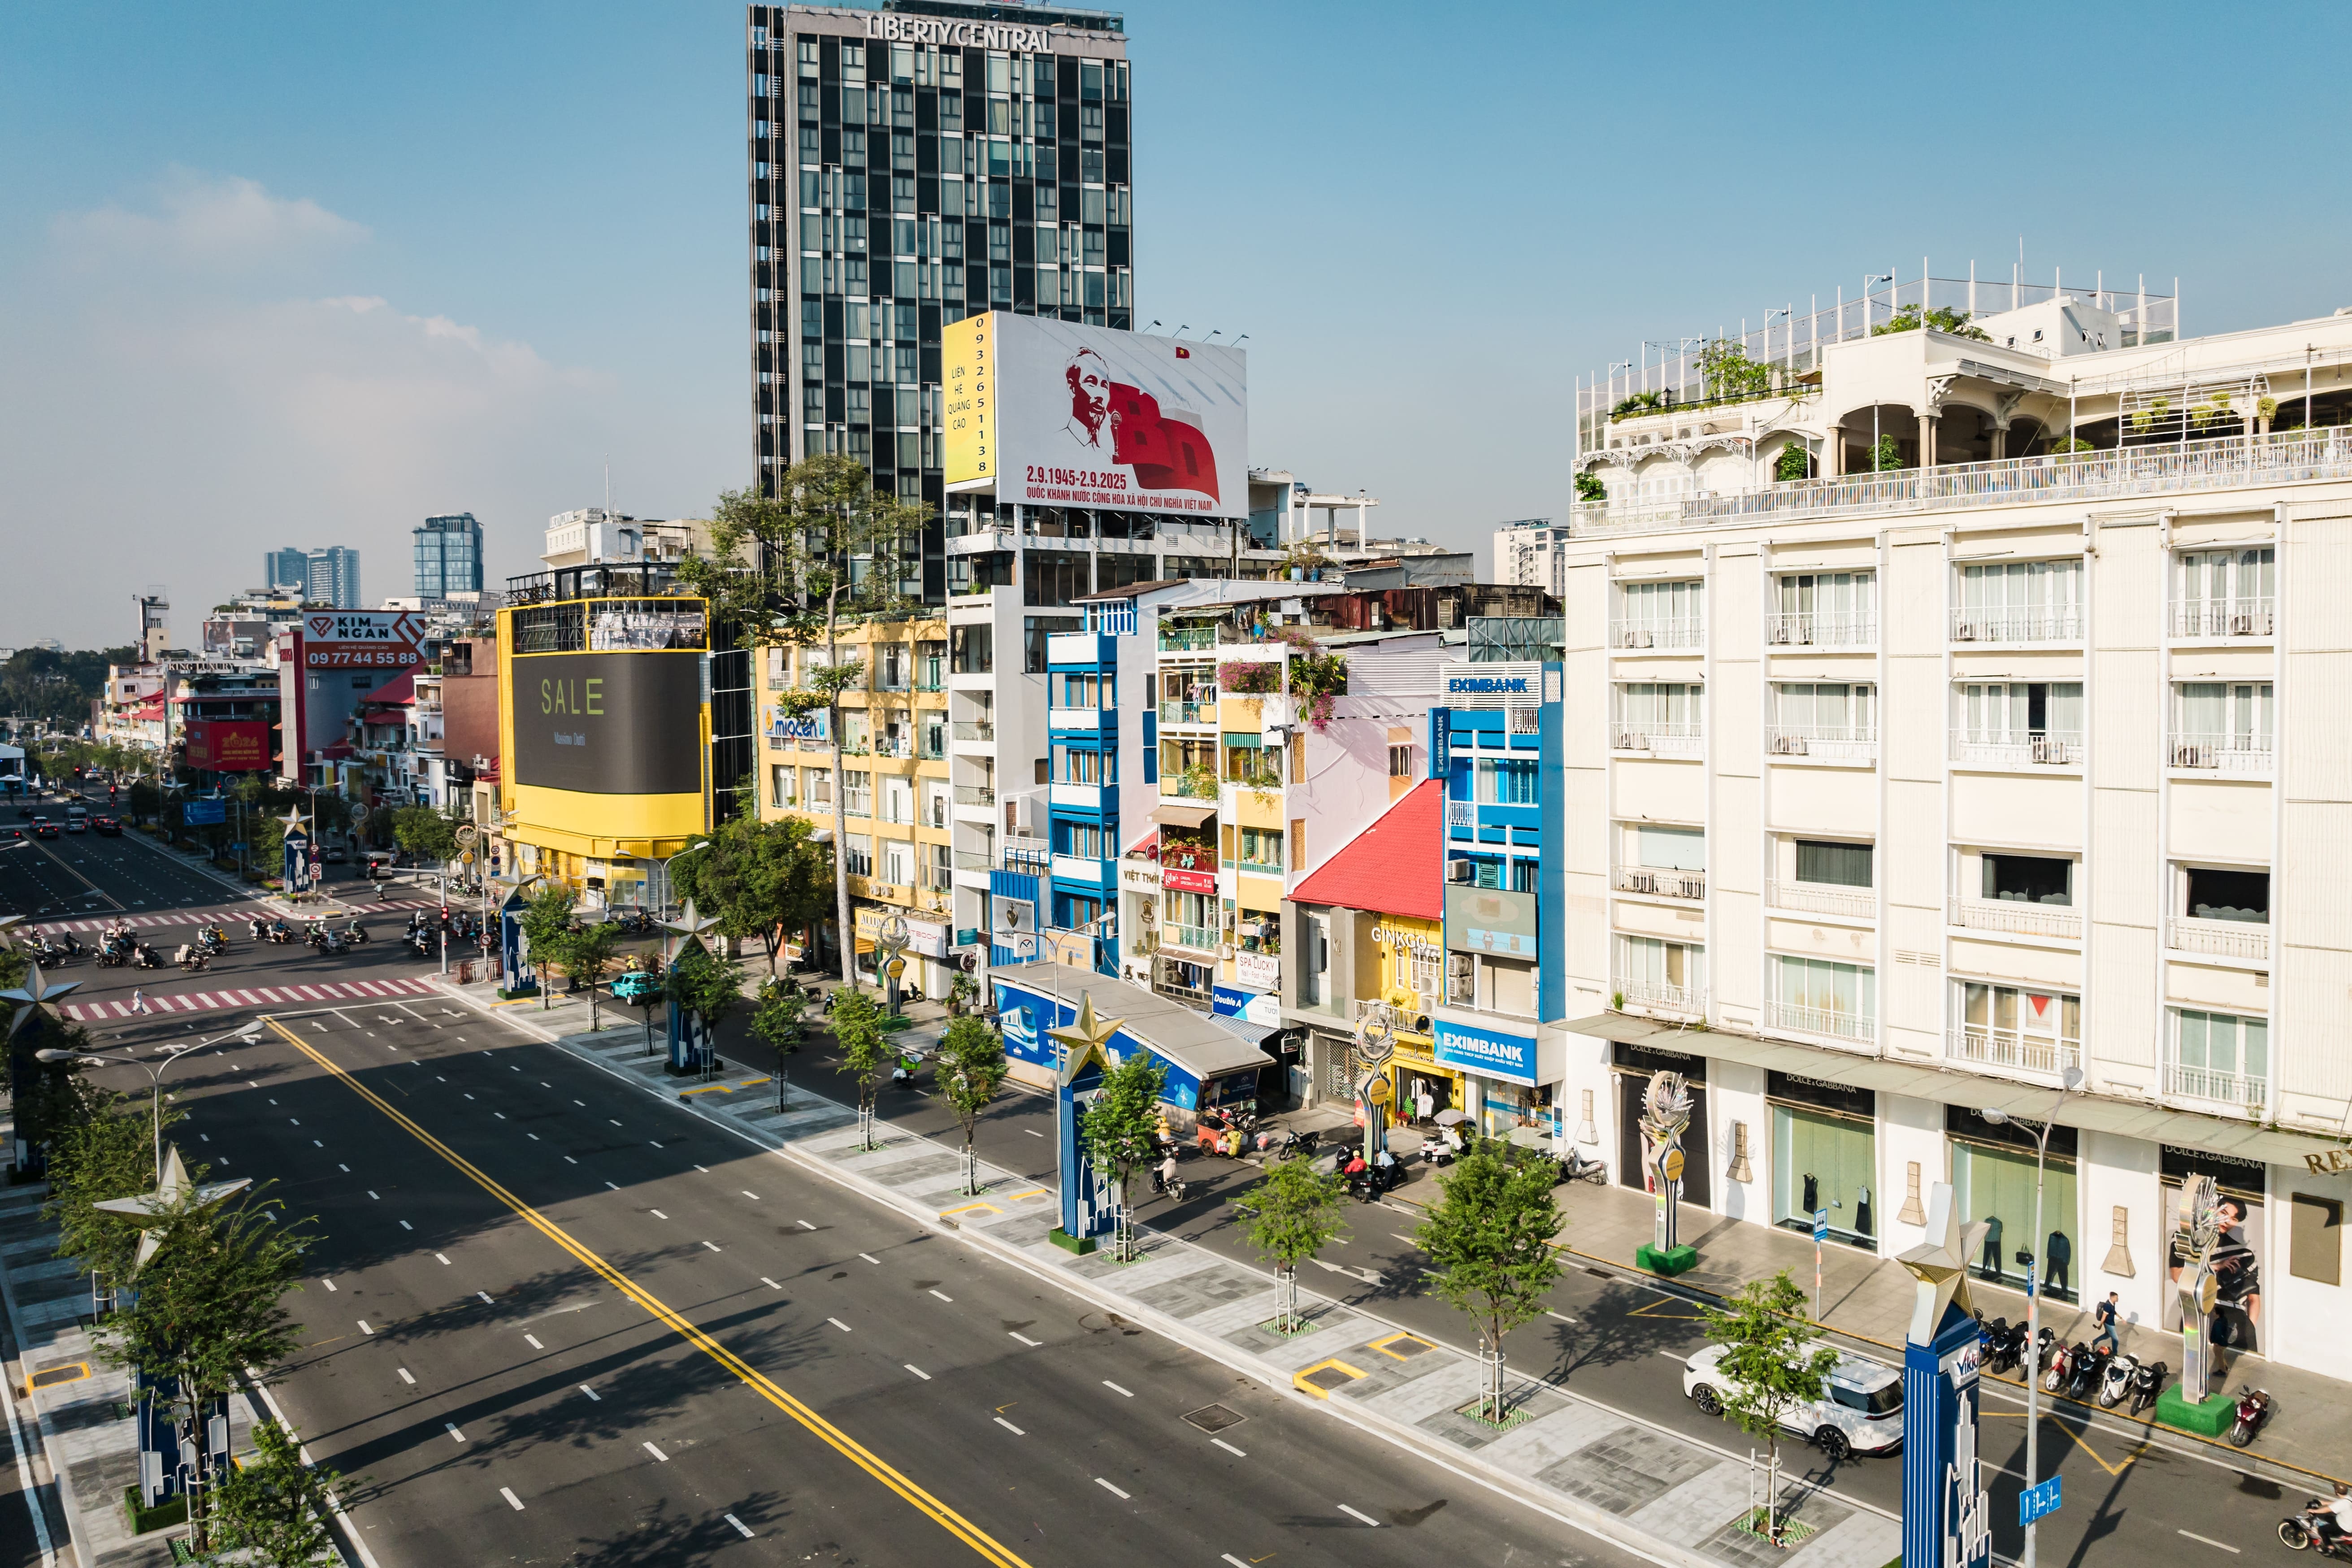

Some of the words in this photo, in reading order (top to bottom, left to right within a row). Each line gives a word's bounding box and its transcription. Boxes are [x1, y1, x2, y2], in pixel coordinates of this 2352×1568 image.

[867, 15, 952, 44] LIBERTY
[955, 23, 1054, 54] CENTRAL
[952, 365, 965, 379] LIÊN
[955, 384, 963, 397] HỆ
[948, 397, 970, 415] QUẢNG
[953, 417, 966, 430] CÁO
[1027, 465, 1127, 490] 2.9.1945-2.9.2025
[1027, 484, 1045, 499] QUỐC
[1047, 487, 1070, 501] KHÁNH
[1072, 489, 1090, 503] NƯỚC
[1092, 491, 1110, 505] CỘNG
[1112, 491, 1125, 505] HÒA
[1127, 493, 1136, 506] XÃ
[1137, 494, 1148, 508] HỘI
[1150, 494, 1162, 508] CHỦ
[1164, 496, 1183, 509] NGHĨA
[1184, 498, 1197, 512] VIỆT
[1198, 500, 1212, 511] NAM
[338, 617, 371, 627] KIM
[338, 628, 389, 638] NGAN
[309, 652, 329, 665] 09
[332, 652, 350, 665] 77
[353, 652, 373, 665] 44
[376, 652, 395, 665] 55
[398, 652, 418, 664] 88
[1449, 678, 1527, 693] EXIMBANK
[542, 678, 604, 715] SALE
[554, 731, 572, 745] Massimo
[1124, 869, 1140, 883] VIỆT
[1165, 872, 1179, 886] ghé
[1371, 927, 1428, 950] GINKGO
[1240, 956, 1252, 968] SPA
[1254, 959, 1274, 973] LUCKY
[1251, 971, 1259, 979] Foot
[1263, 973, 1273, 982] Facial
[1214, 994, 1236, 1007] Double
[1236, 999, 1241, 1008] A
[1443, 1032, 1523, 1062] EXIMBANK
[1631, 1044, 1652, 1054] DOLCE
[1656, 1048, 1691, 1061] GABBANA
[1787, 1073, 1811, 1086] DOLCE
[1816, 1079, 1857, 1094] GABBANA
[2165, 1145, 2199, 1158] DOLCE
[2205, 1152, 2264, 1171] GABBANA
